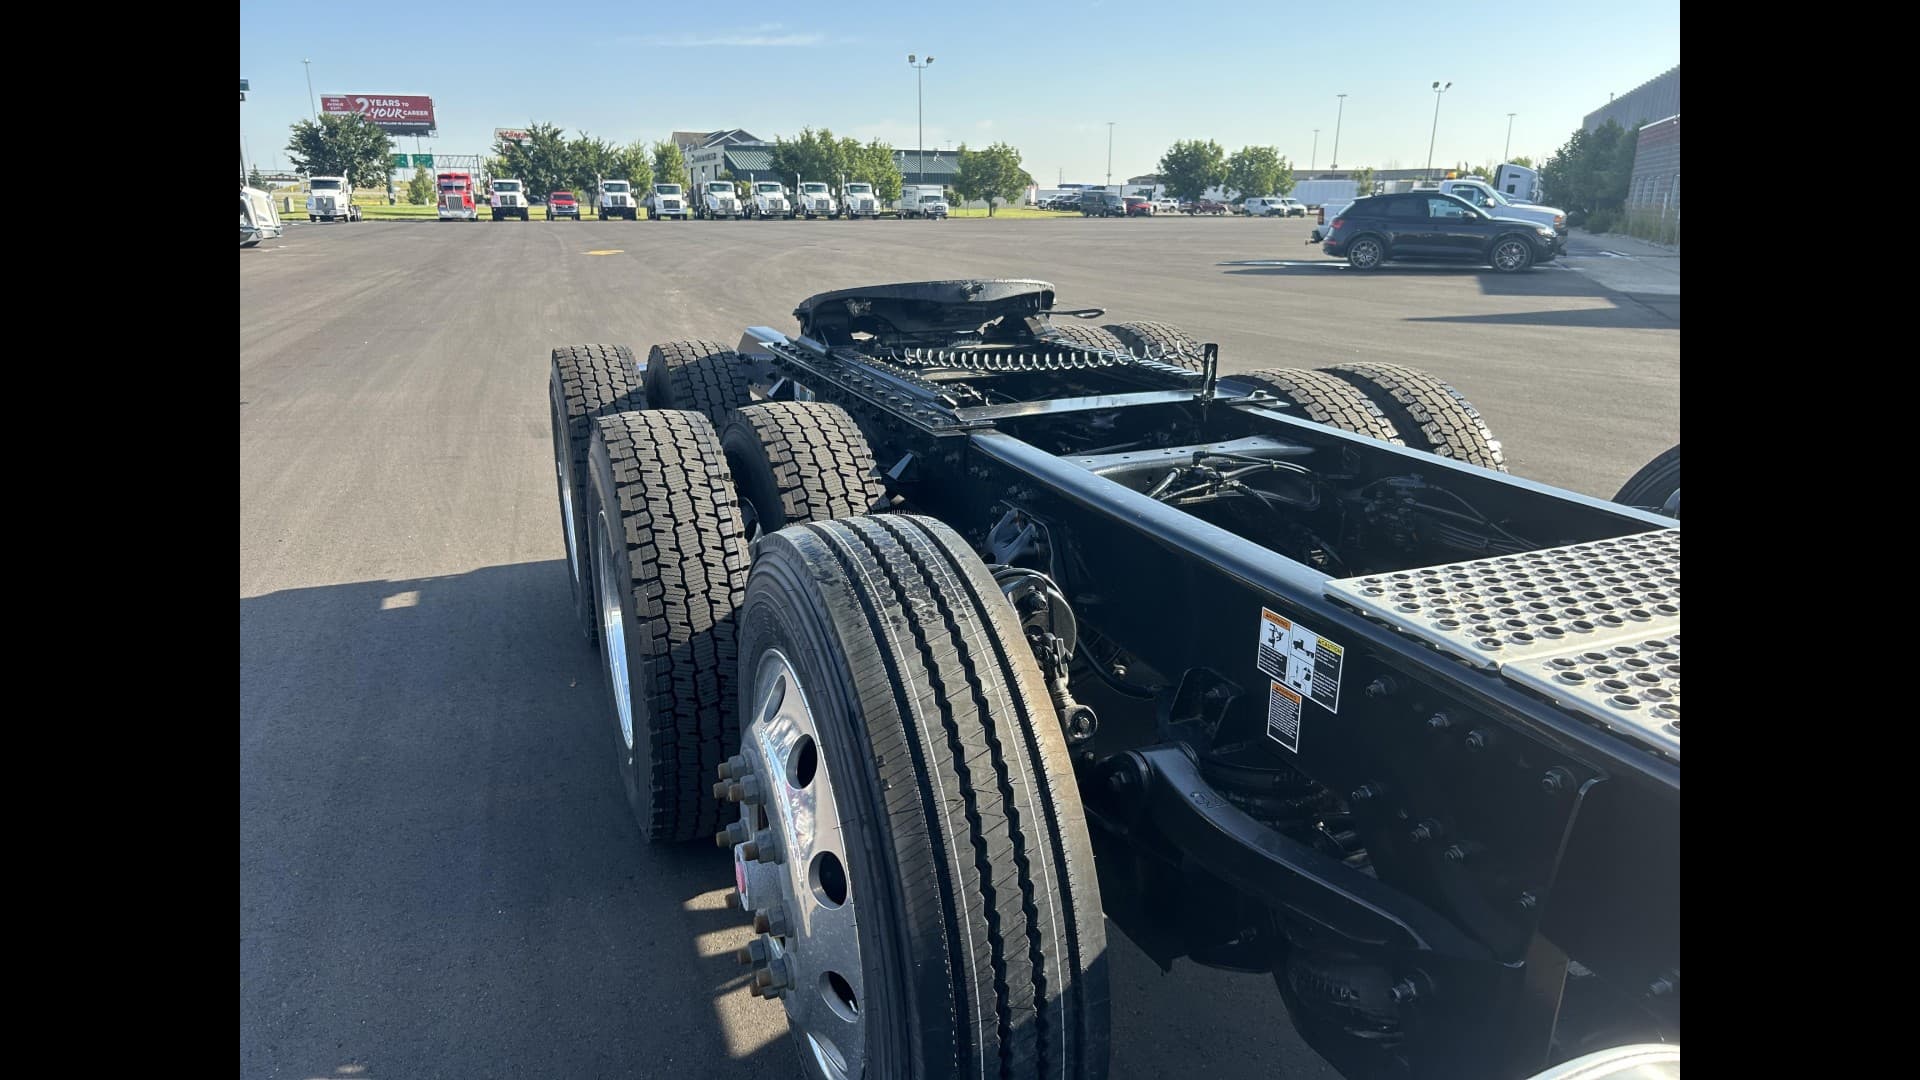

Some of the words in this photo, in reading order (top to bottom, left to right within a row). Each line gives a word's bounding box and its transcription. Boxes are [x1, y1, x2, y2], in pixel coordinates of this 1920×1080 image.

[355, 97, 370, 116] 2
[370, 99, 401, 107] YEARS
[371, 107, 406, 119] YOUR
